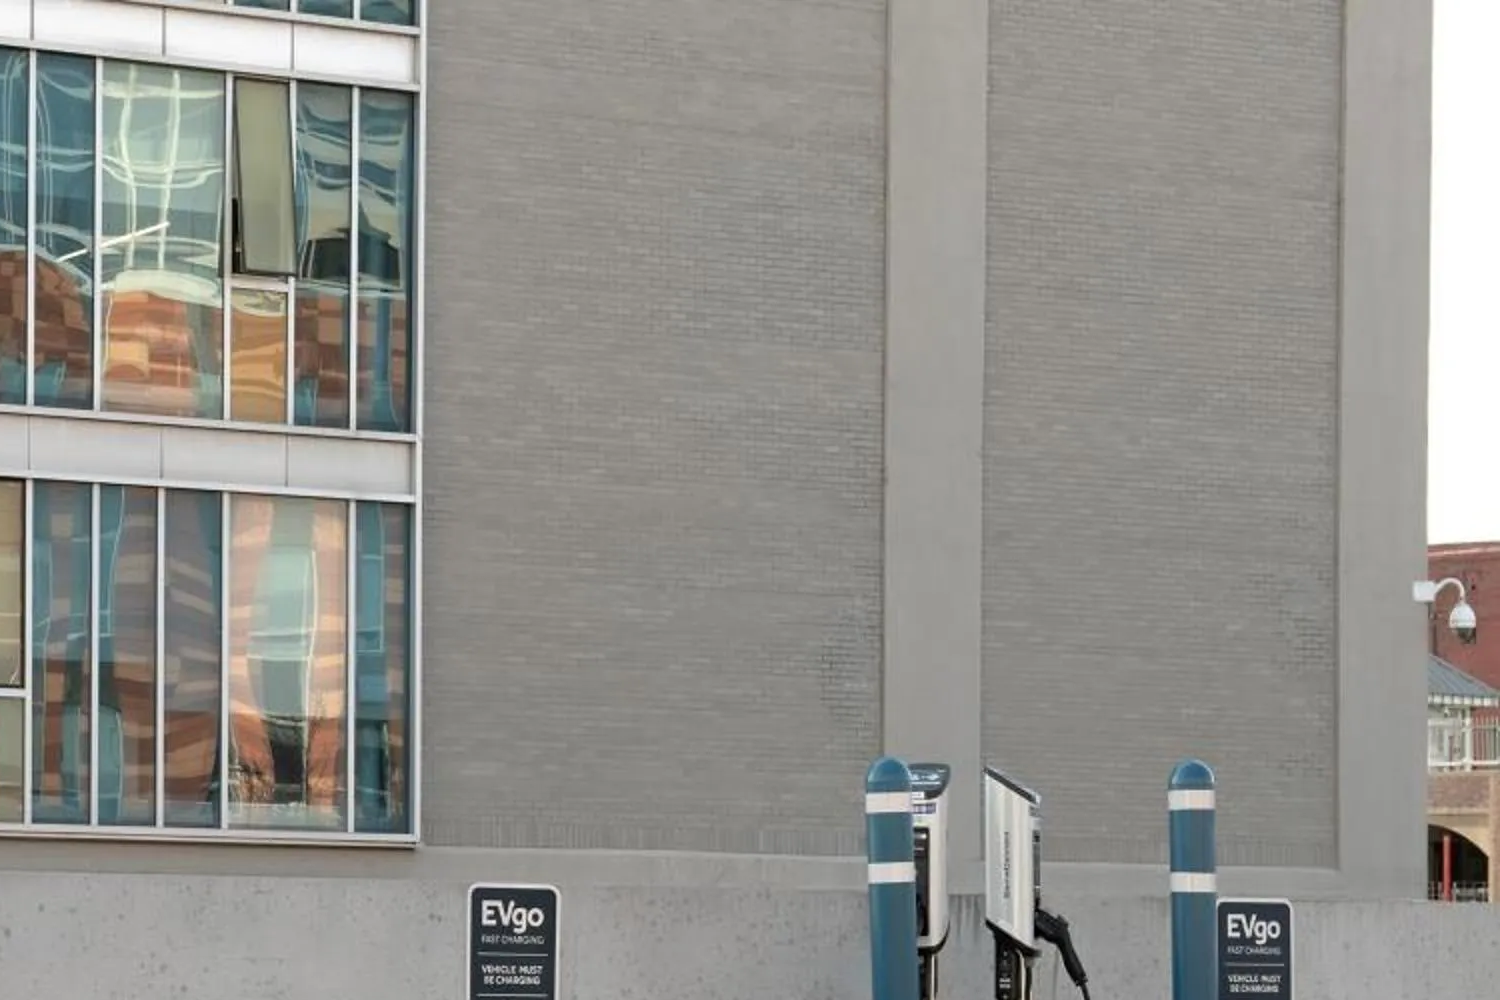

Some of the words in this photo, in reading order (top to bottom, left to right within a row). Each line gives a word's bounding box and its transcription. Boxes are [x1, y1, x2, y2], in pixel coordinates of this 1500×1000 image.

[481, 899, 544, 934] EVgo
[1227, 913, 1281, 945] EVgo
[481, 965, 516, 974] VEHICLE
[519, 965, 543, 974] MUST
[484, 976, 494, 985] BE
[495, 976, 540, 985] CHARGING
